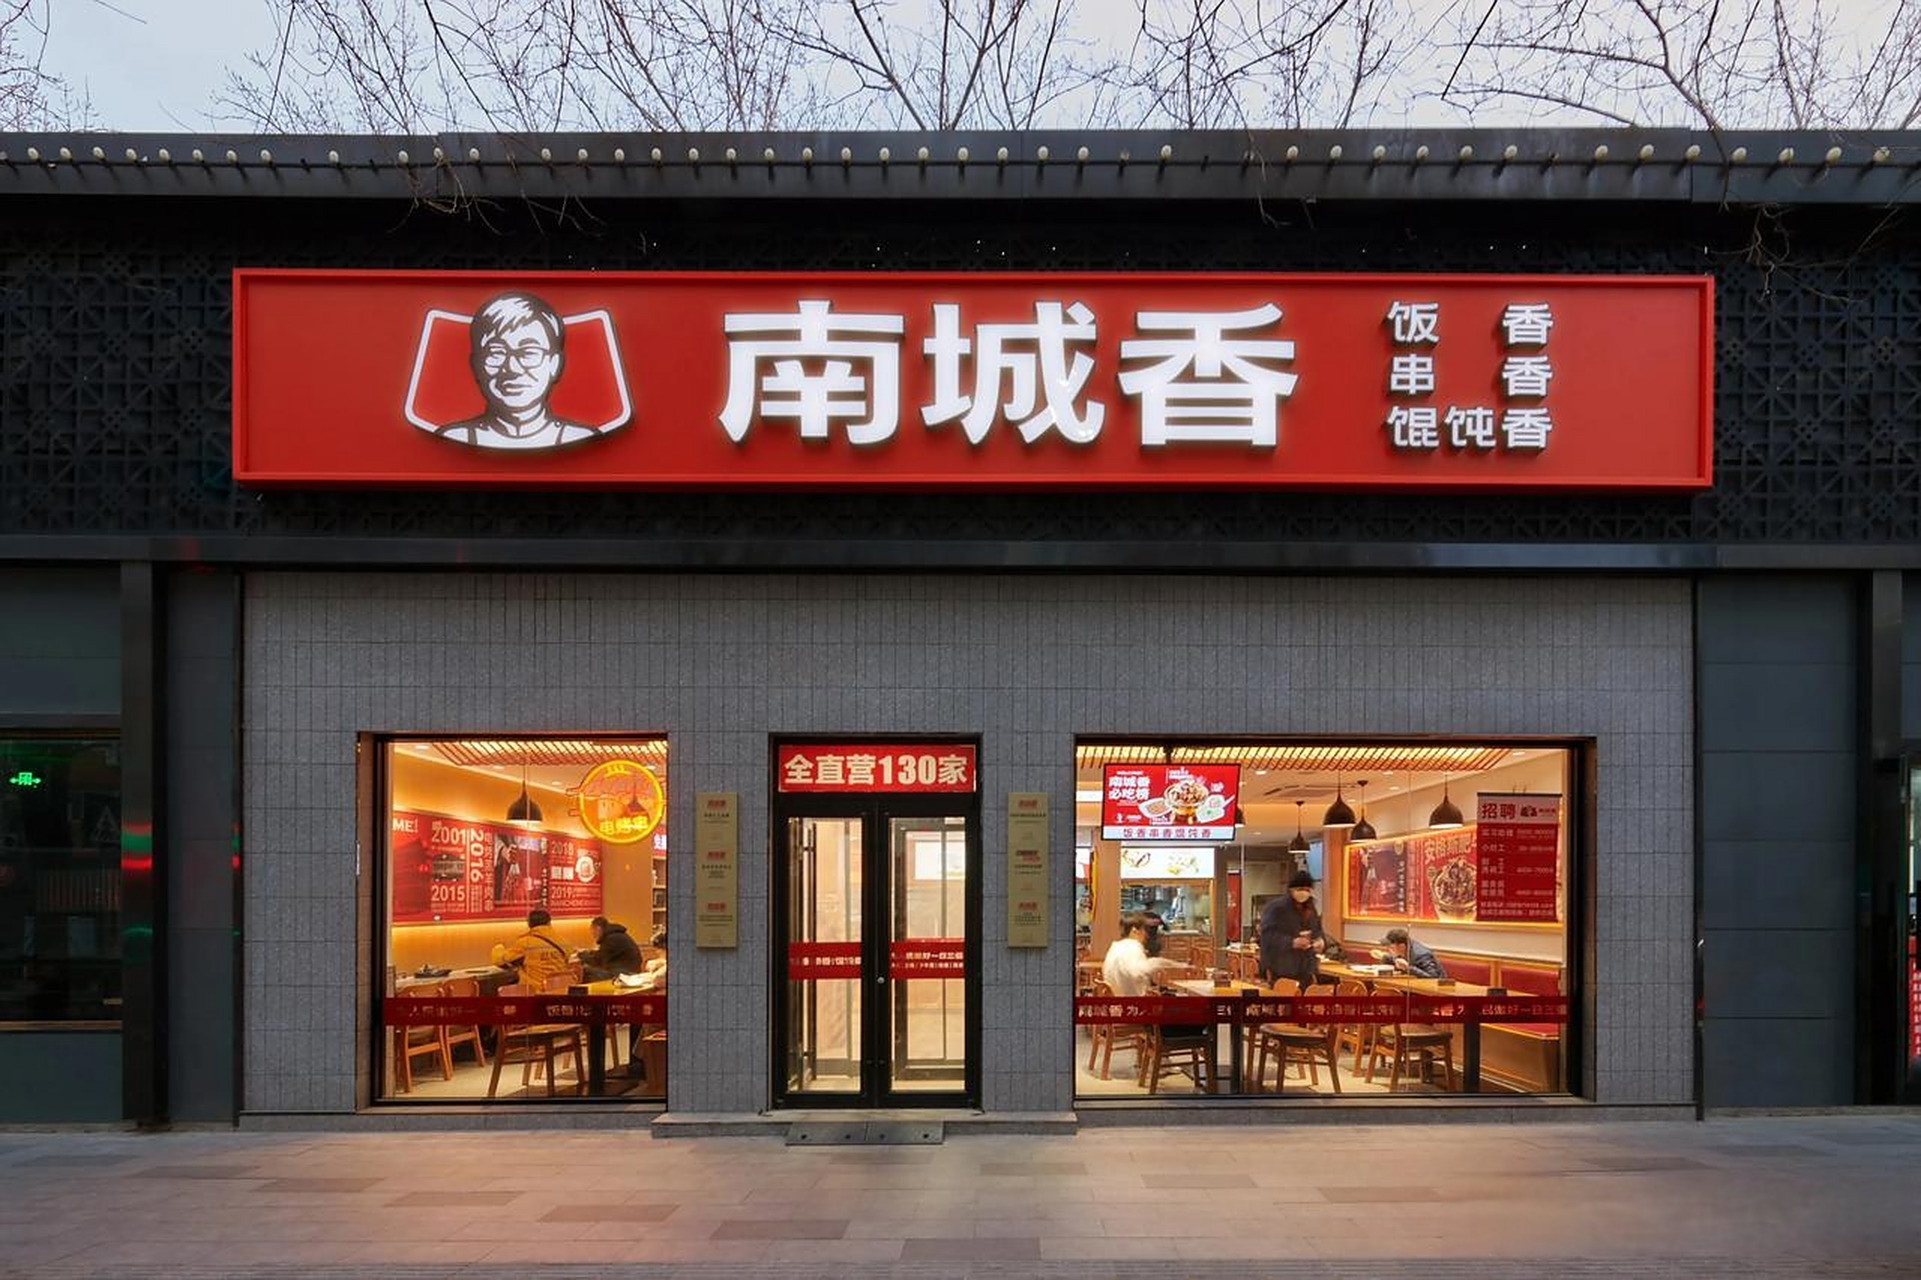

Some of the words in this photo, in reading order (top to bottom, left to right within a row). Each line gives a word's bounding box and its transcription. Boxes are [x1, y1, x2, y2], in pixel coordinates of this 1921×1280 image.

[1387, 301, 1439, 344] 饭
[1501, 303, 1553, 346] 香
[717, 300, 1298, 447] 南城香
[1389, 355, 1436, 394] 串
[1501, 355, 1553, 398] 香
[1387, 406, 1553, 450] 馄饨香
[784, 754, 968, 785] 全直营130家
[1481, 803, 1516, 819] 招聘
[432, 826, 467, 845] 2001
[470, 828, 484, 882] 2016
[431, 885, 466, 901] 2015
